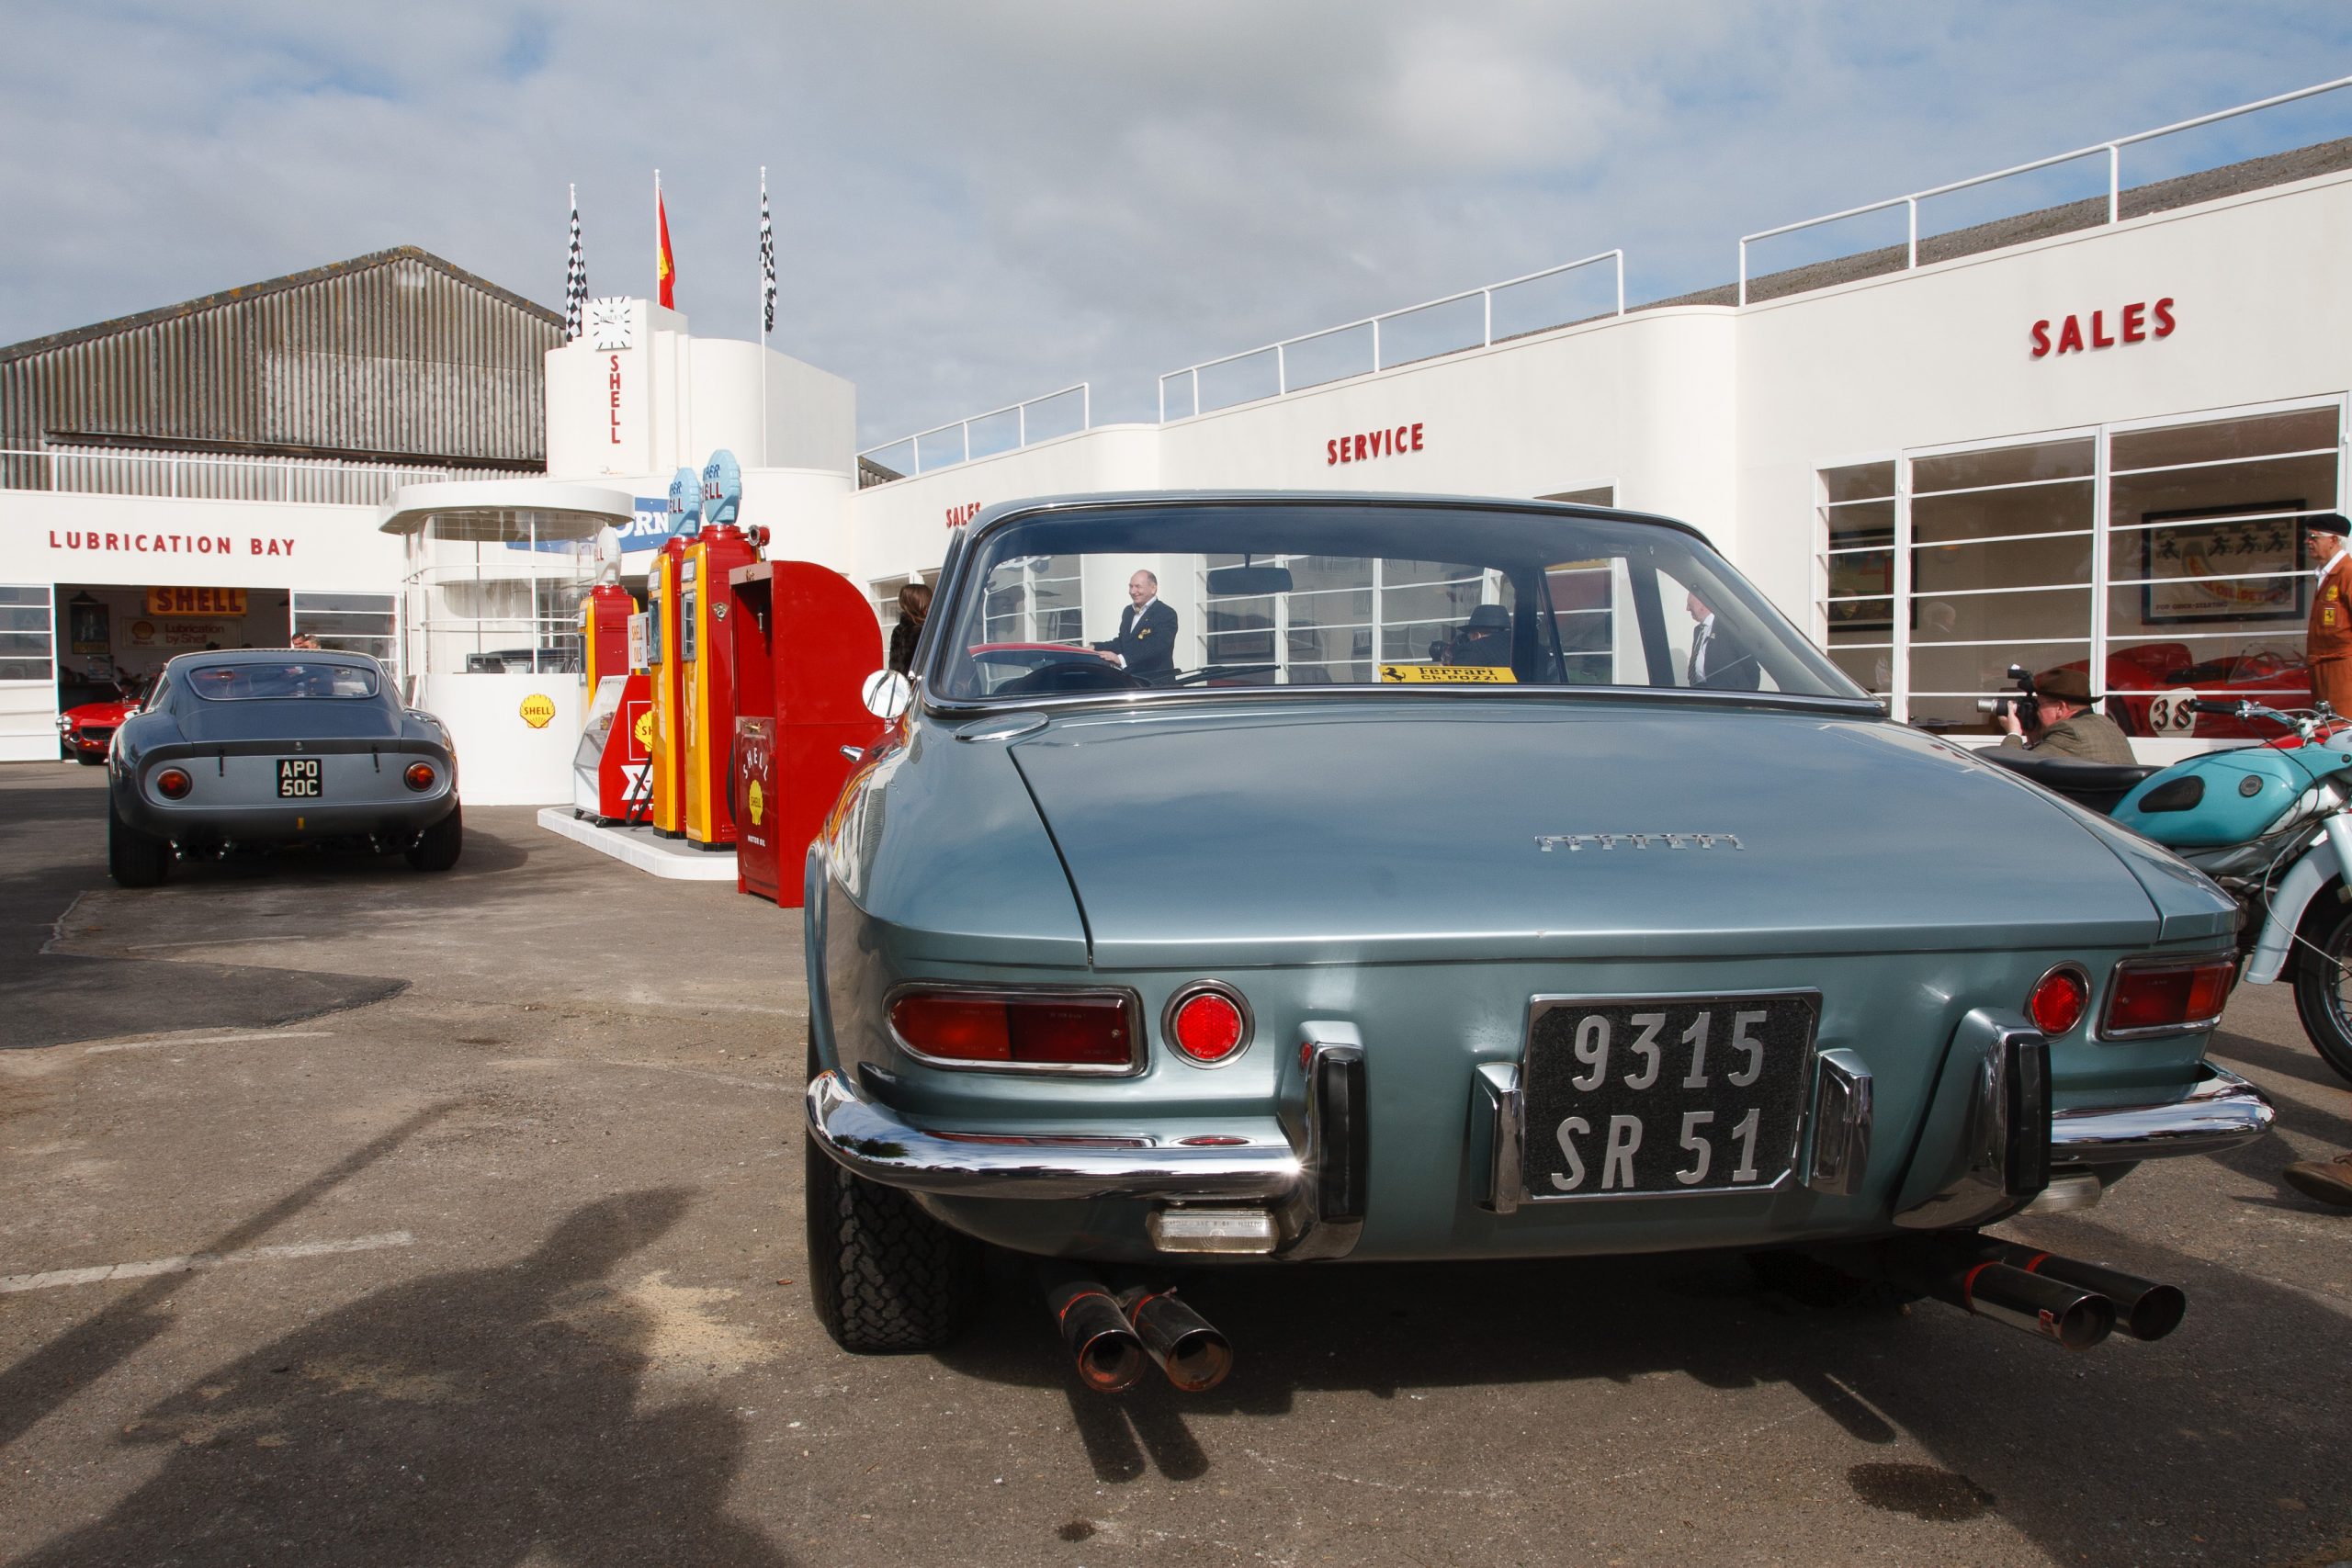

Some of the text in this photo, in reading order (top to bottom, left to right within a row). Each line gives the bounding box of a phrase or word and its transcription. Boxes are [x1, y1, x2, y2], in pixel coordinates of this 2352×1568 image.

[2032, 298, 2176, 357] SALES
[610, 355, 620, 444] SHELL
[1328, 423, 1423, 465] SERVICE
[50, 530, 295, 556] LUBRICATION BAY
[156, 588, 243, 612] SHELL
[165, 624, 224, 634] Lubrication
[524, 706, 550, 716] SHELL
[2153, 699, 2192, 731] 38
[282, 761, 318, 777] APO
[742, 748, 768, 781] SHELL
[282, 779, 318, 796] 50C
[1572, 1011, 1767, 1091] 9315
[1551, 1108, 1760, 1190] SR 51
